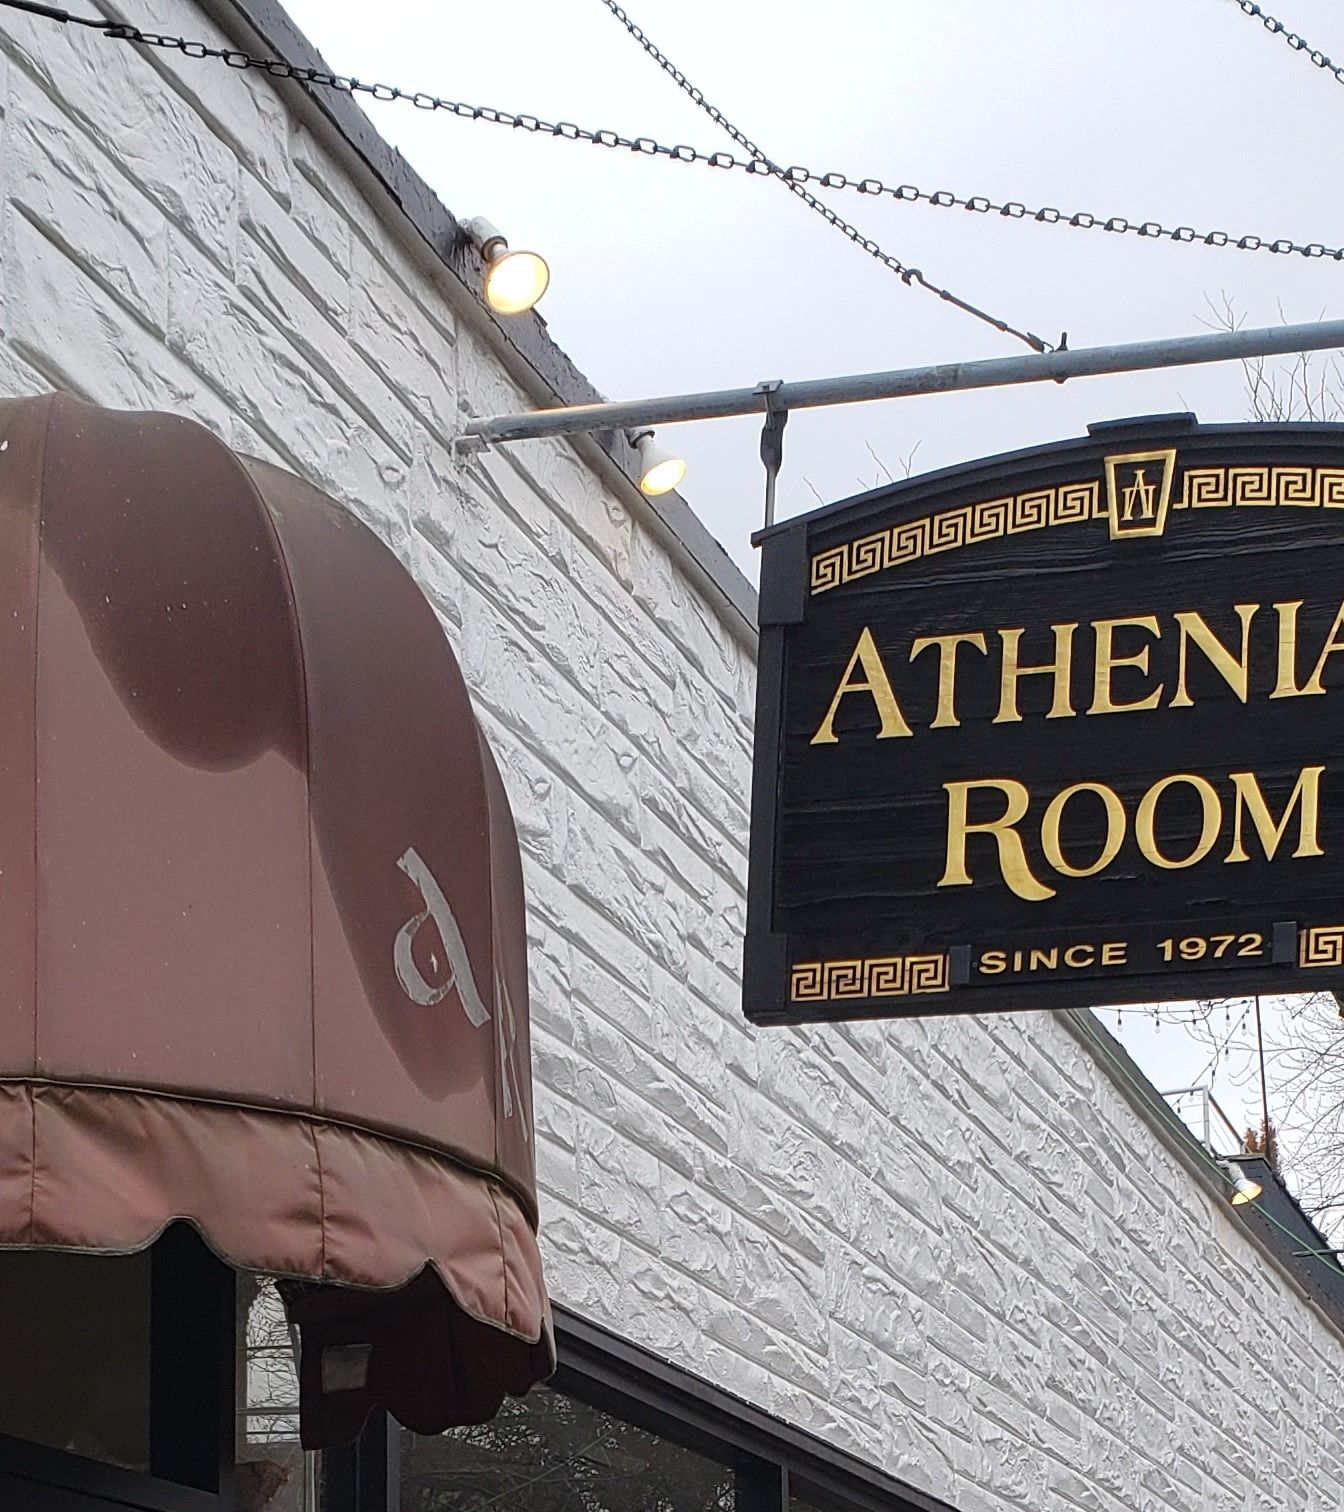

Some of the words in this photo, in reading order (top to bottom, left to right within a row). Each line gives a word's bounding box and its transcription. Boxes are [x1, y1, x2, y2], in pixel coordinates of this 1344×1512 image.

[937, 765, 1326, 902] ROOM
[979, 942, 1127, 974] SINCE
[1156, 933, 1264, 961] 1972
